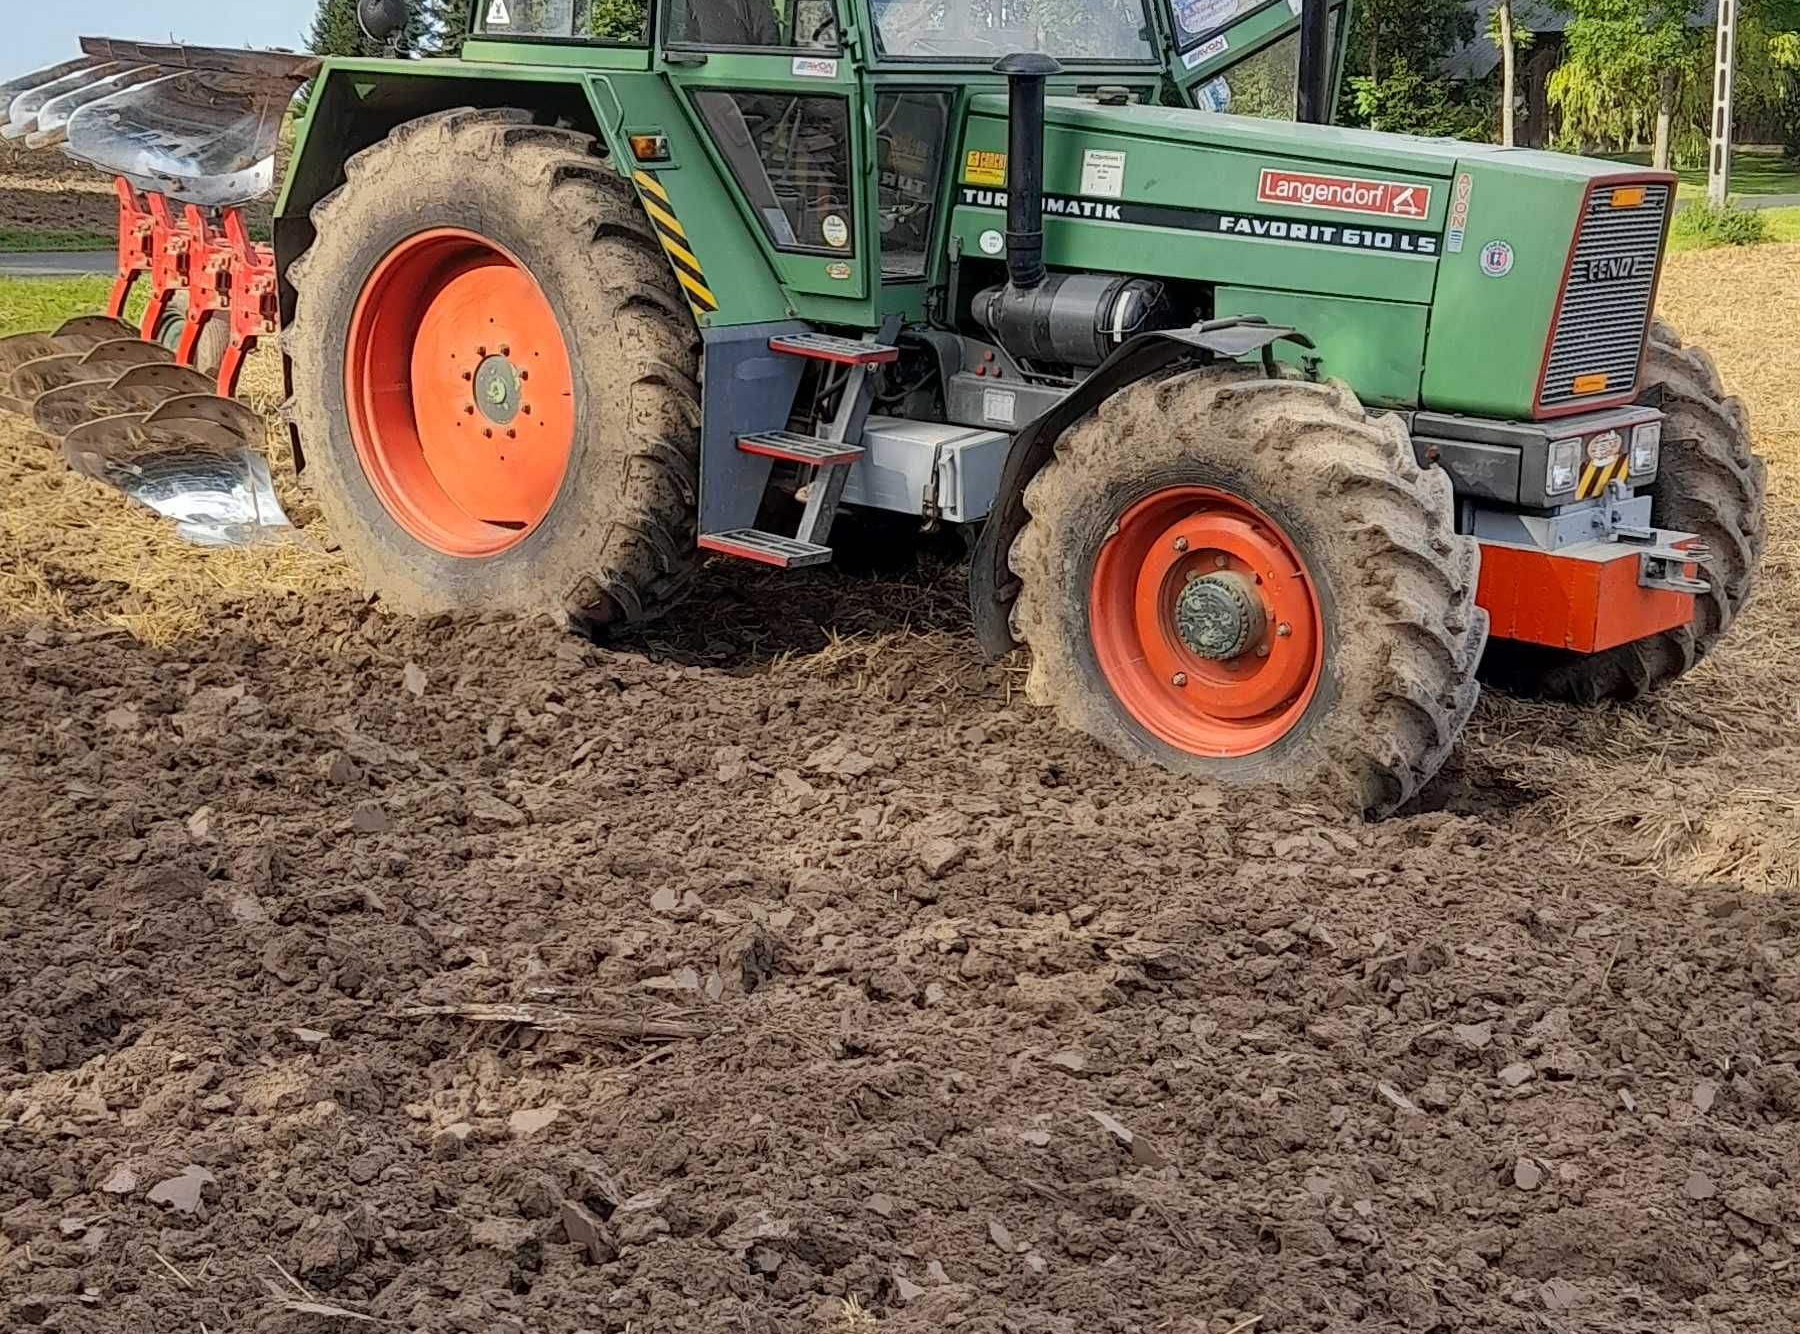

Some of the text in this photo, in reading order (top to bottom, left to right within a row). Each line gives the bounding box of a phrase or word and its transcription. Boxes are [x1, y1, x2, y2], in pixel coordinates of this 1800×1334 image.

[962, 188, 1122, 220] TURMATIK
[1265, 173, 1385, 207] Langendorf
[1452, 174, 1470, 227] AVON
[1219, 216, 1437, 253] FAVORIT 610 LS
[1588, 256, 1646, 281] FENDT
